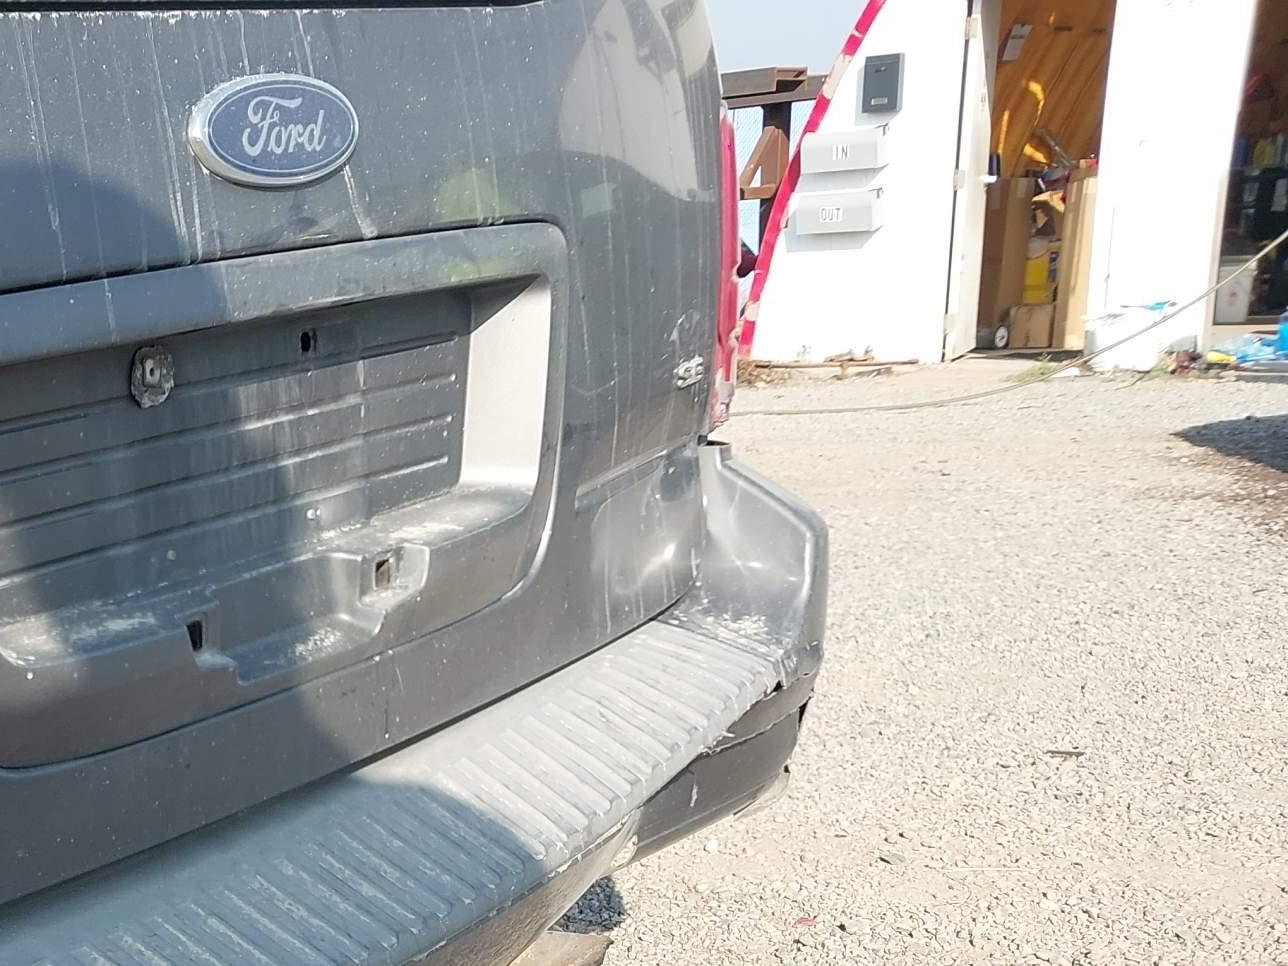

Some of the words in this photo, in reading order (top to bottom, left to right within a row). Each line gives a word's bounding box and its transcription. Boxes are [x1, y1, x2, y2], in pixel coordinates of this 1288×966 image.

[242, 95, 327, 156] Ford
[835, 144, 849, 160] IN
[820, 207, 841, 222] OUT
